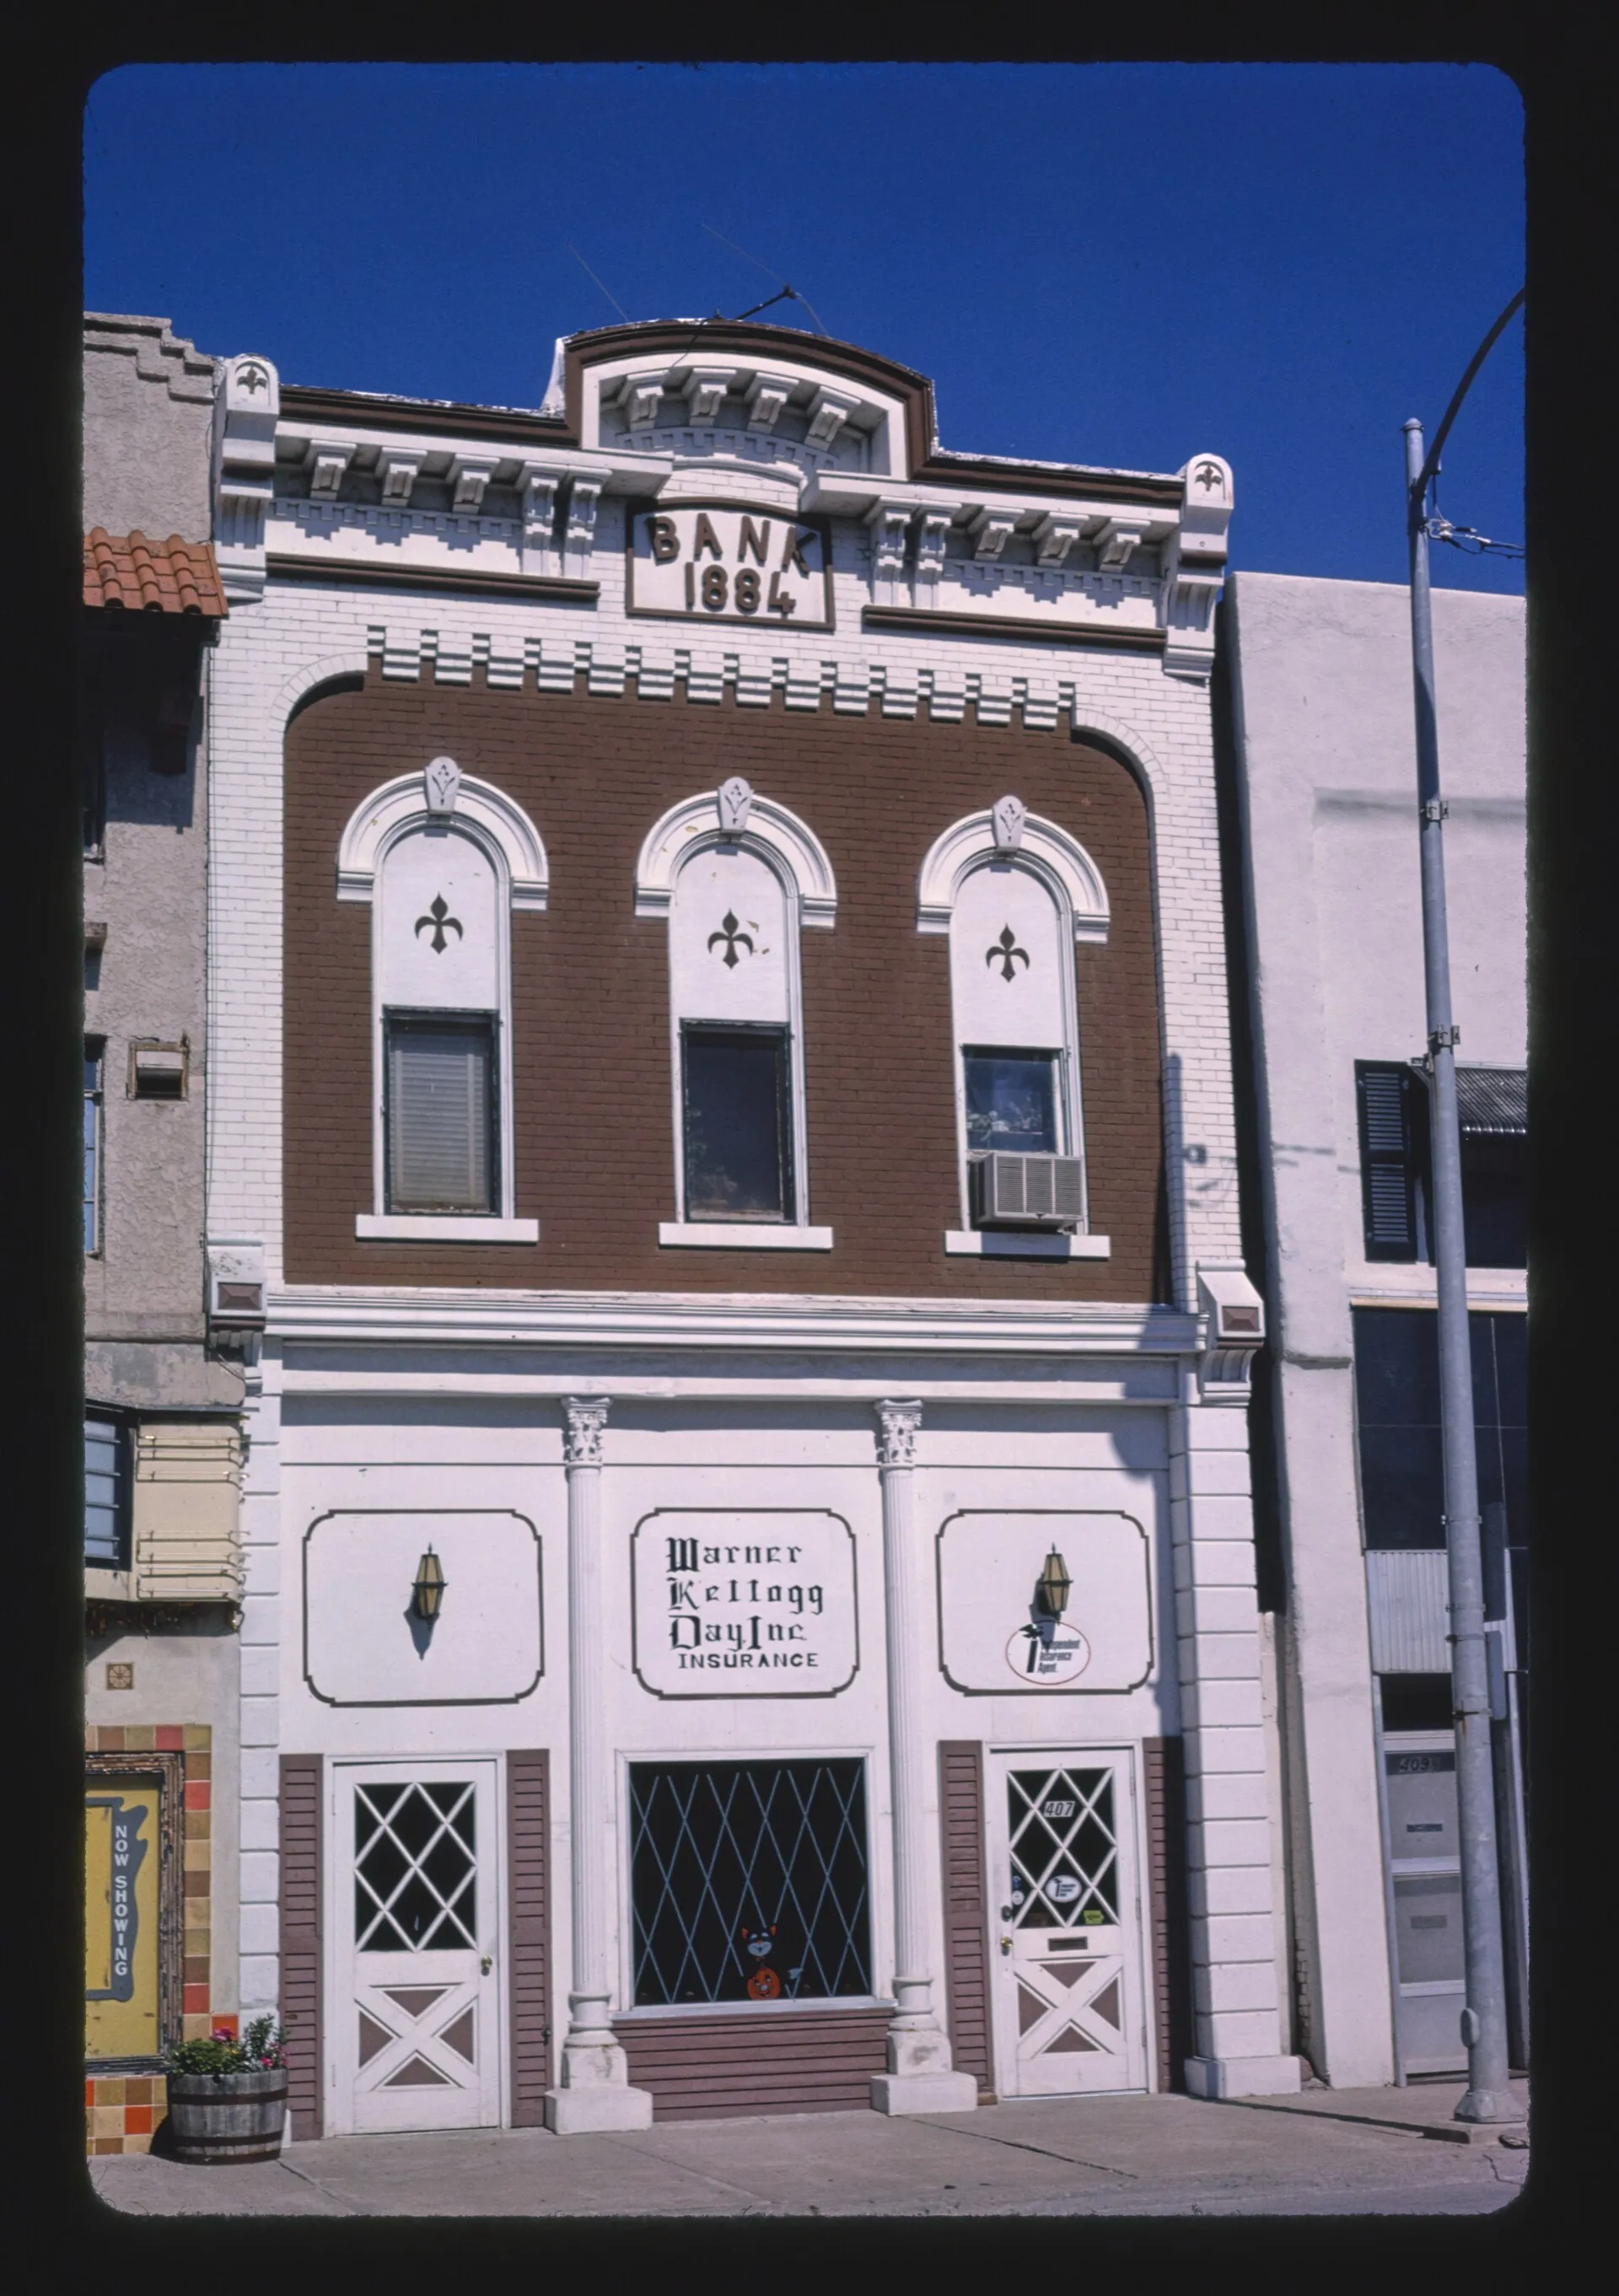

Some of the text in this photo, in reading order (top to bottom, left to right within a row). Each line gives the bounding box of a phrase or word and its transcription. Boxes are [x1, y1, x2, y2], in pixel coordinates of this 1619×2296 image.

[644, 512, 817, 578] BANK
[684, 562, 797, 620] 1884
[665, 1537, 802, 1573] Warner
[665, 1577, 823, 1616] Kellogg
[678, 1653, 819, 1669] INSURANCE
[1046, 1802, 1073, 1816] 407
[114, 1825, 129, 1976] NOW SHOWING
